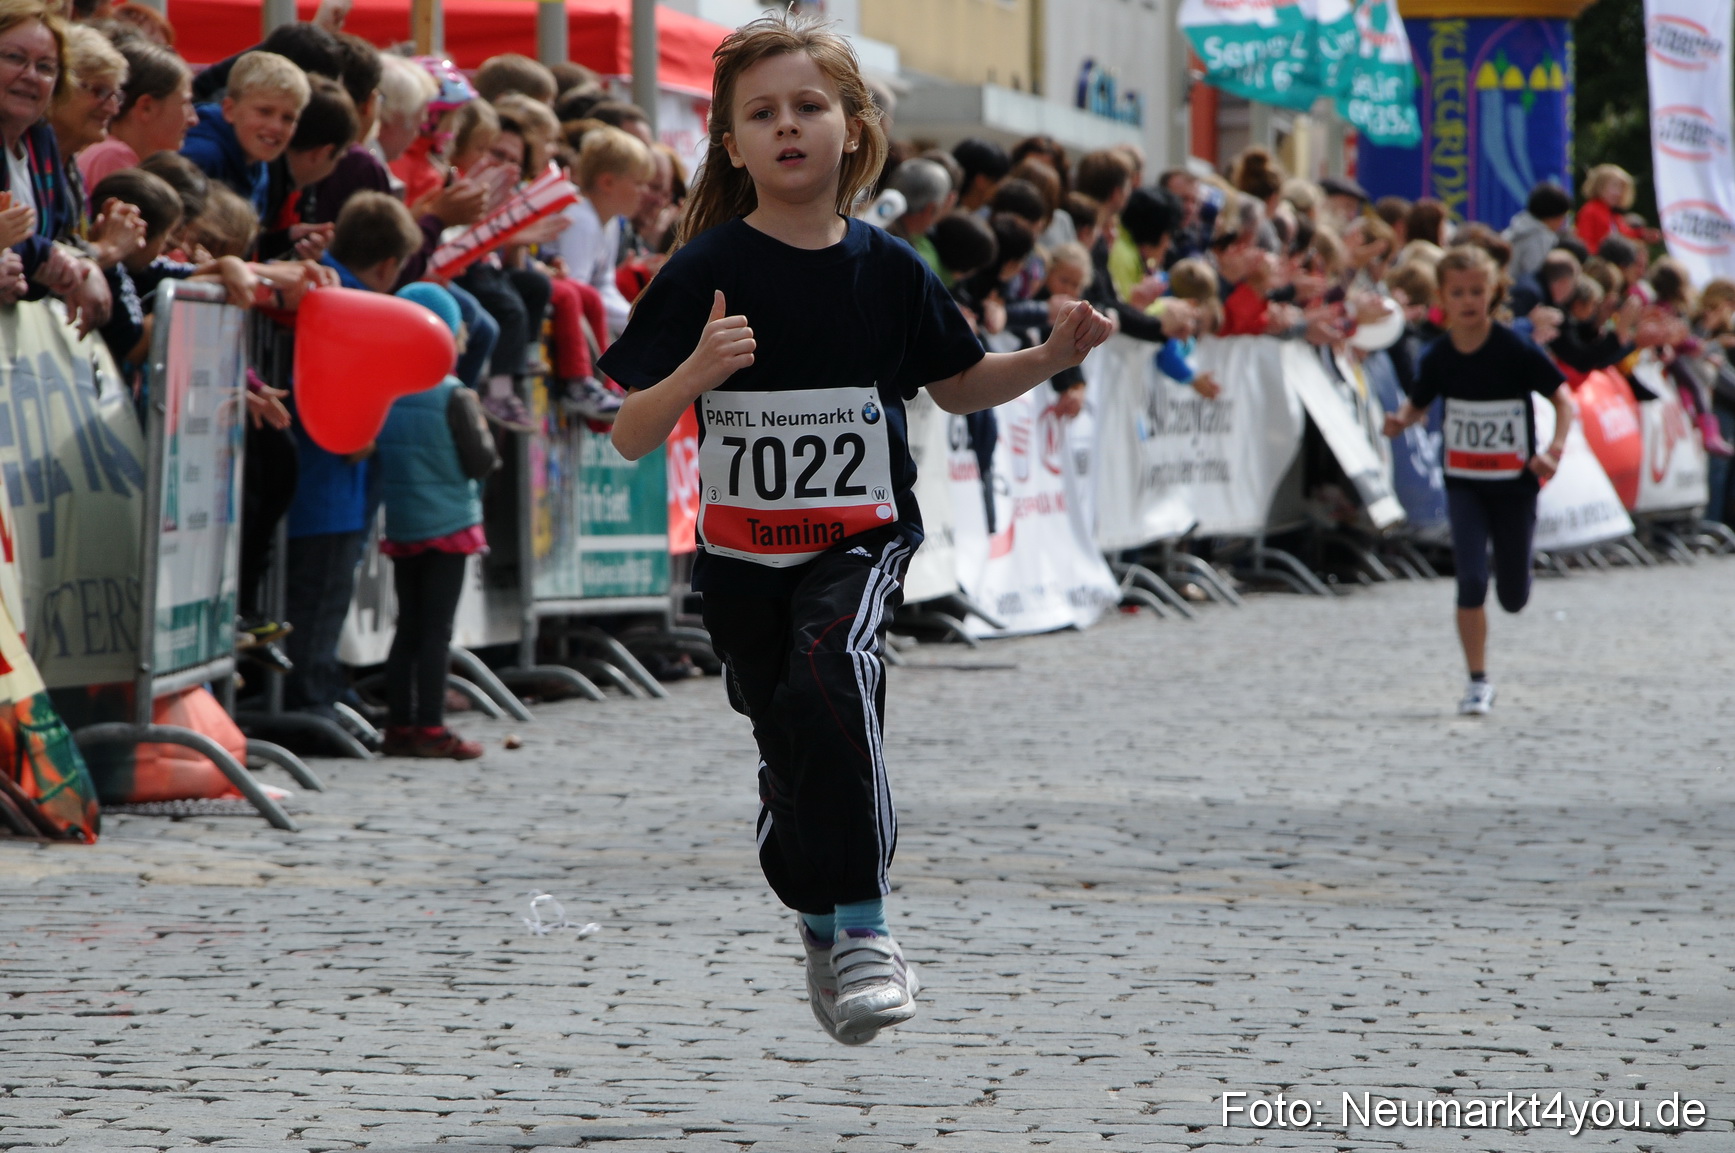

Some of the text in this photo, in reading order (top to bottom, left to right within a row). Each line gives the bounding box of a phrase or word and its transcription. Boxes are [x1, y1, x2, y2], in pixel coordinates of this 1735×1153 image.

[705, 407, 855, 428] PARTL Neumarkt
[1452, 419, 1515, 448] 7024
[721, 432, 868, 501] 7022
[710, 489, 718, 500] 3
[874, 489, 886, 500] W
[746, 517, 846, 547] Tamina
